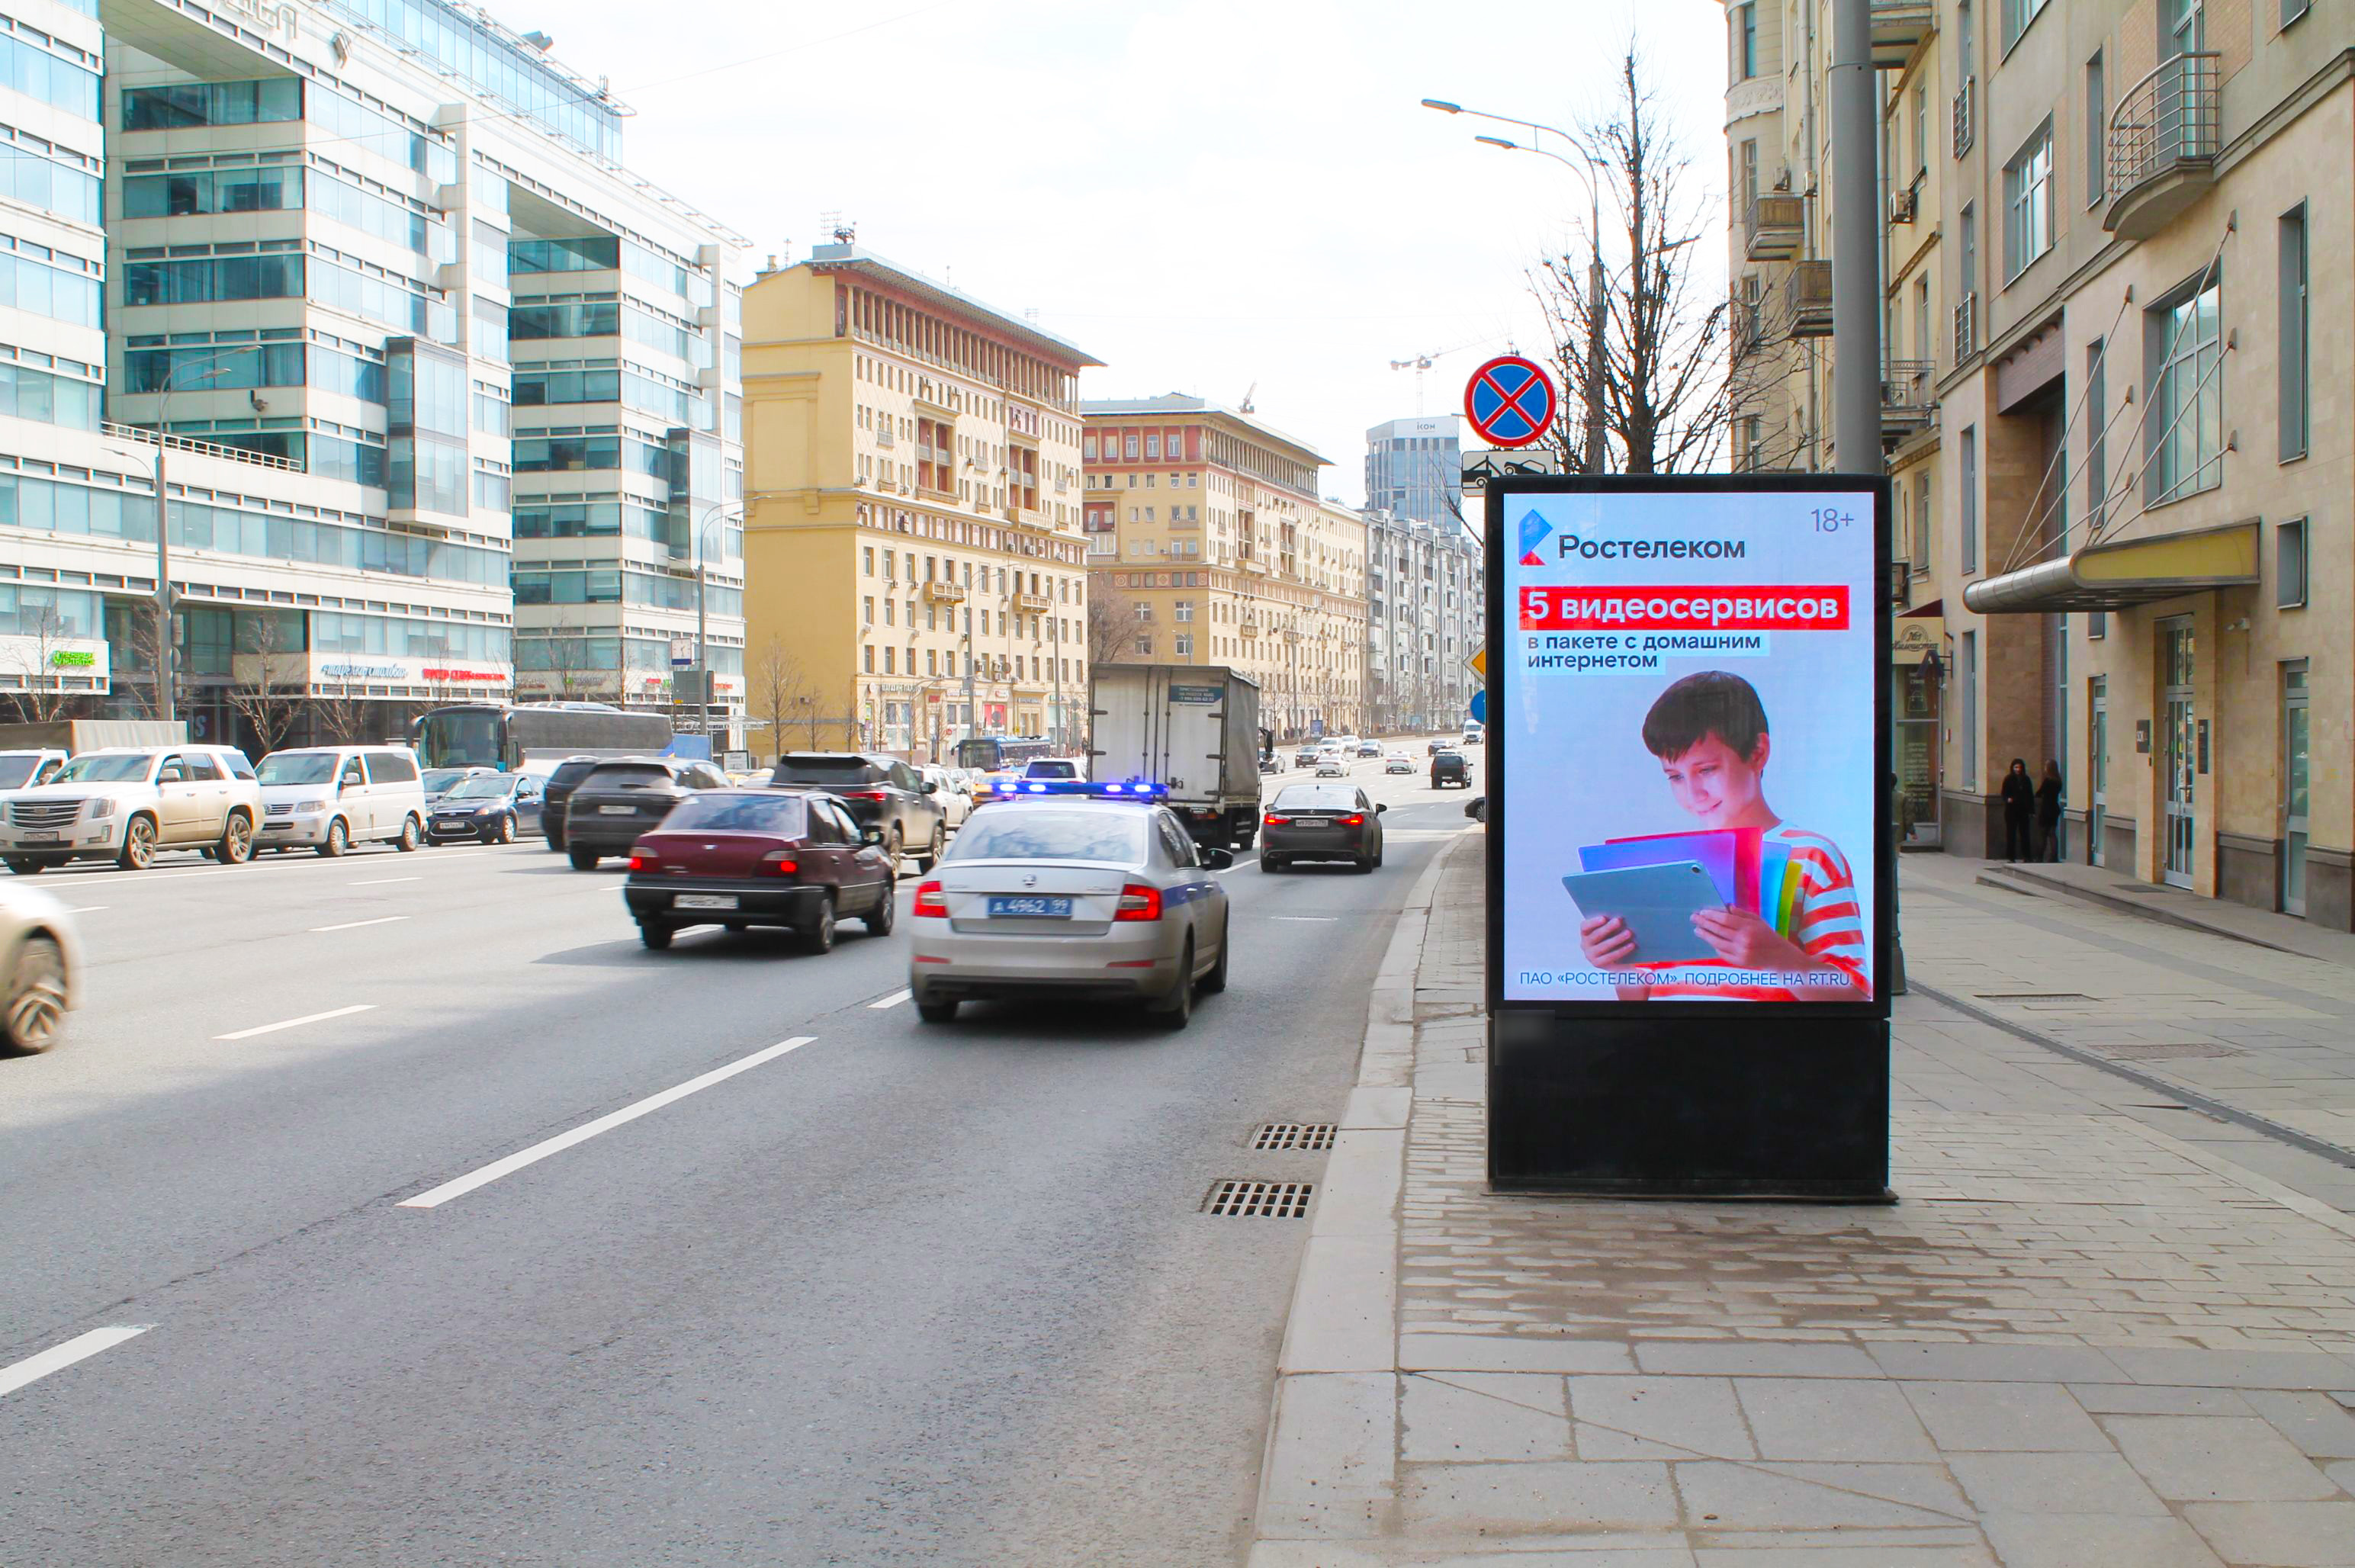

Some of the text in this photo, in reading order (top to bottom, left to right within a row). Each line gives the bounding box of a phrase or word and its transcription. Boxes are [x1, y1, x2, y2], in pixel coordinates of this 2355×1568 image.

[1810, 508, 1855, 532] 18+
[1559, 534, 1745, 559] Ростелеком
[1528, 592, 1839, 626] 5 видеосервисов
[1528, 636, 1761, 651] в пакете с домашним
[1528, 654, 1658, 672] интернетом
[1007, 898, 1046, 913] 4962
[1051, 898, 1068, 910] 99
[1519, 972, 1852, 986] ПАО «РОСТЕЛЕКОМ». ПОДРОБНЕЕ НА RT.RU.
